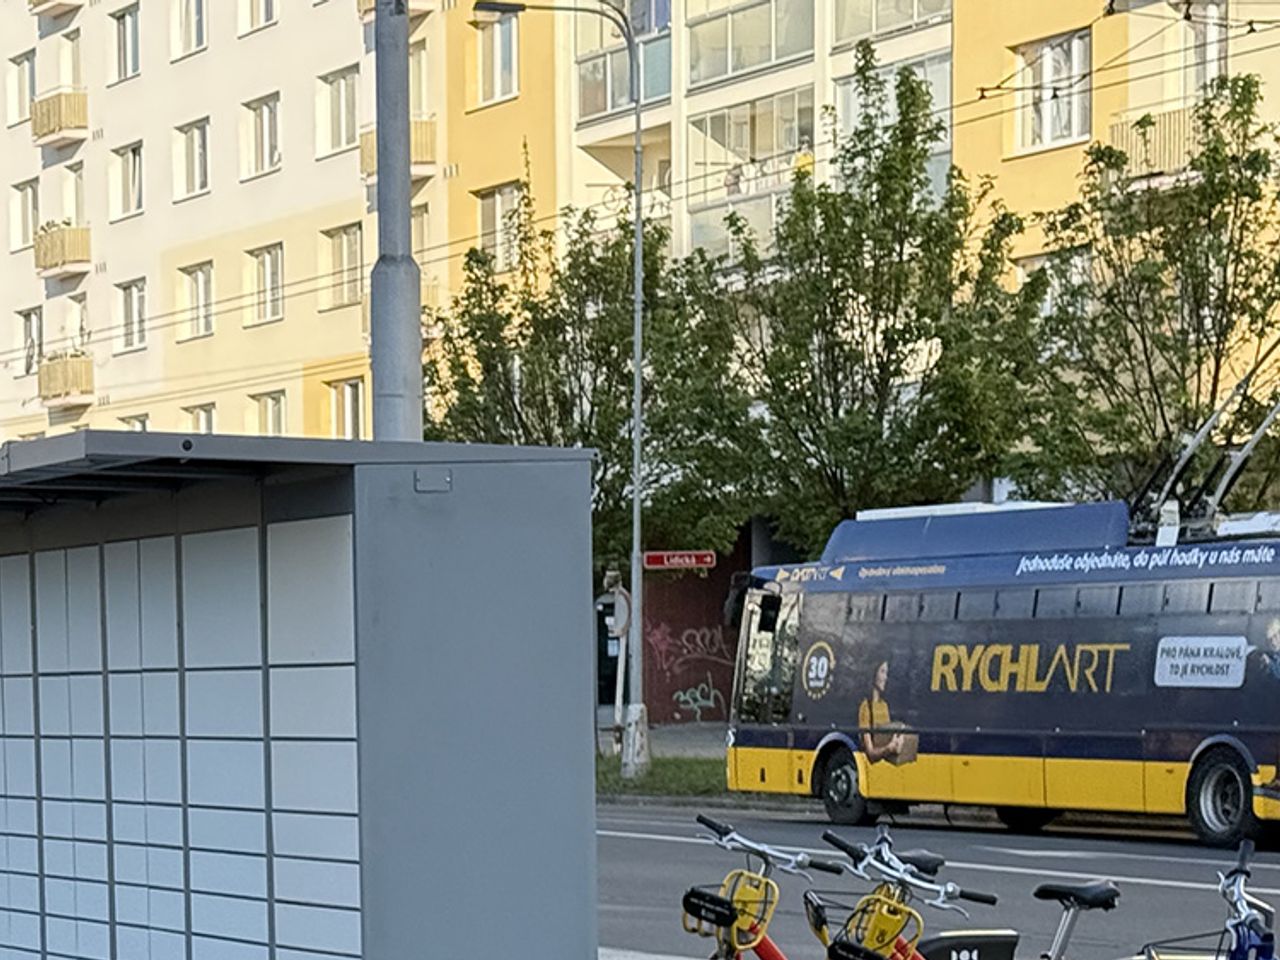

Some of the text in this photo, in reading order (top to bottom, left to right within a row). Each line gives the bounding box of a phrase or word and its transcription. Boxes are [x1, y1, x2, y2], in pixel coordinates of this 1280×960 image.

[1133, 549, 1149, 567] do
[1209, 550, 1219, 565] u
[1242, 546, 1276, 564] máte
[809, 656, 828, 679] 30
[930, 643, 1131, 693] RYCHLART
